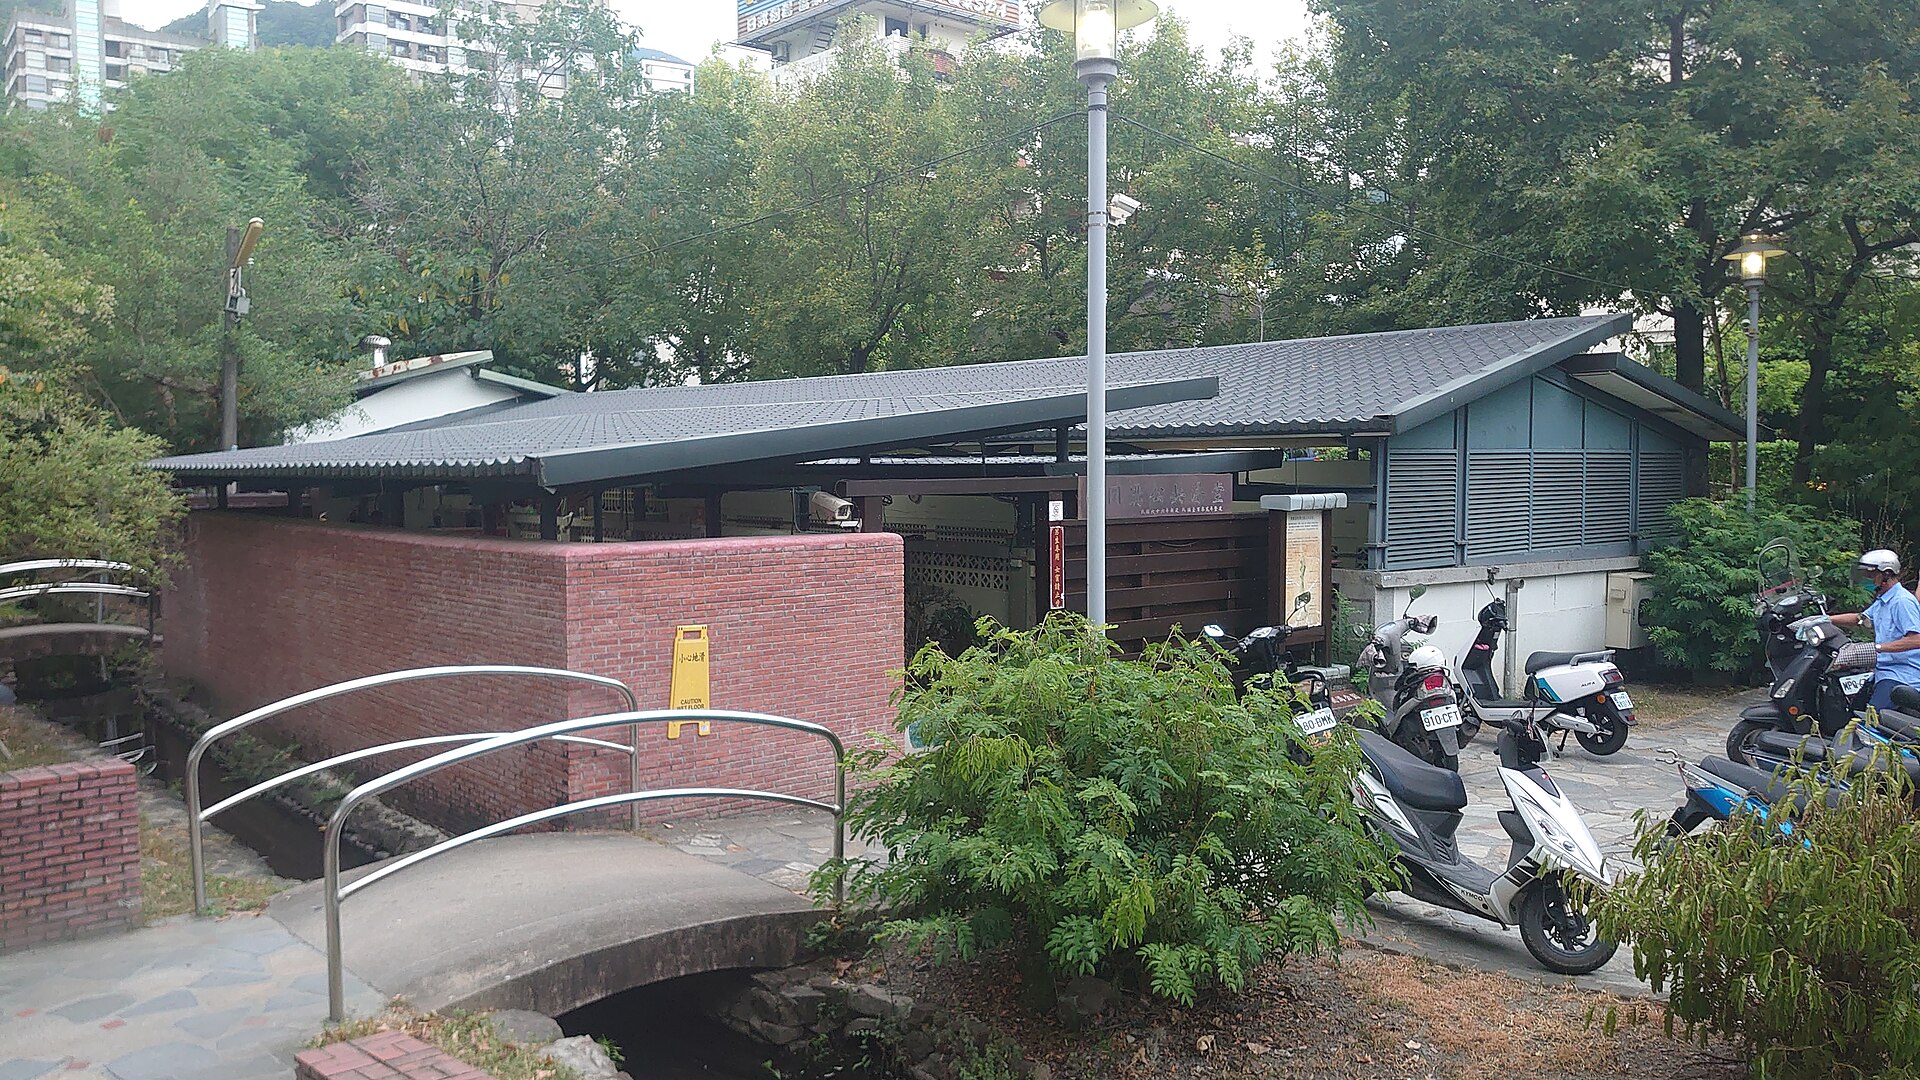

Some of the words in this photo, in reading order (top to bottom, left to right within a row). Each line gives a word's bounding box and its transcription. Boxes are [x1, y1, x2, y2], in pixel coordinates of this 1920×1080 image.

[679, 652, 705, 663] 小心地滑
[1461, 890, 1483, 901] KYMCO
